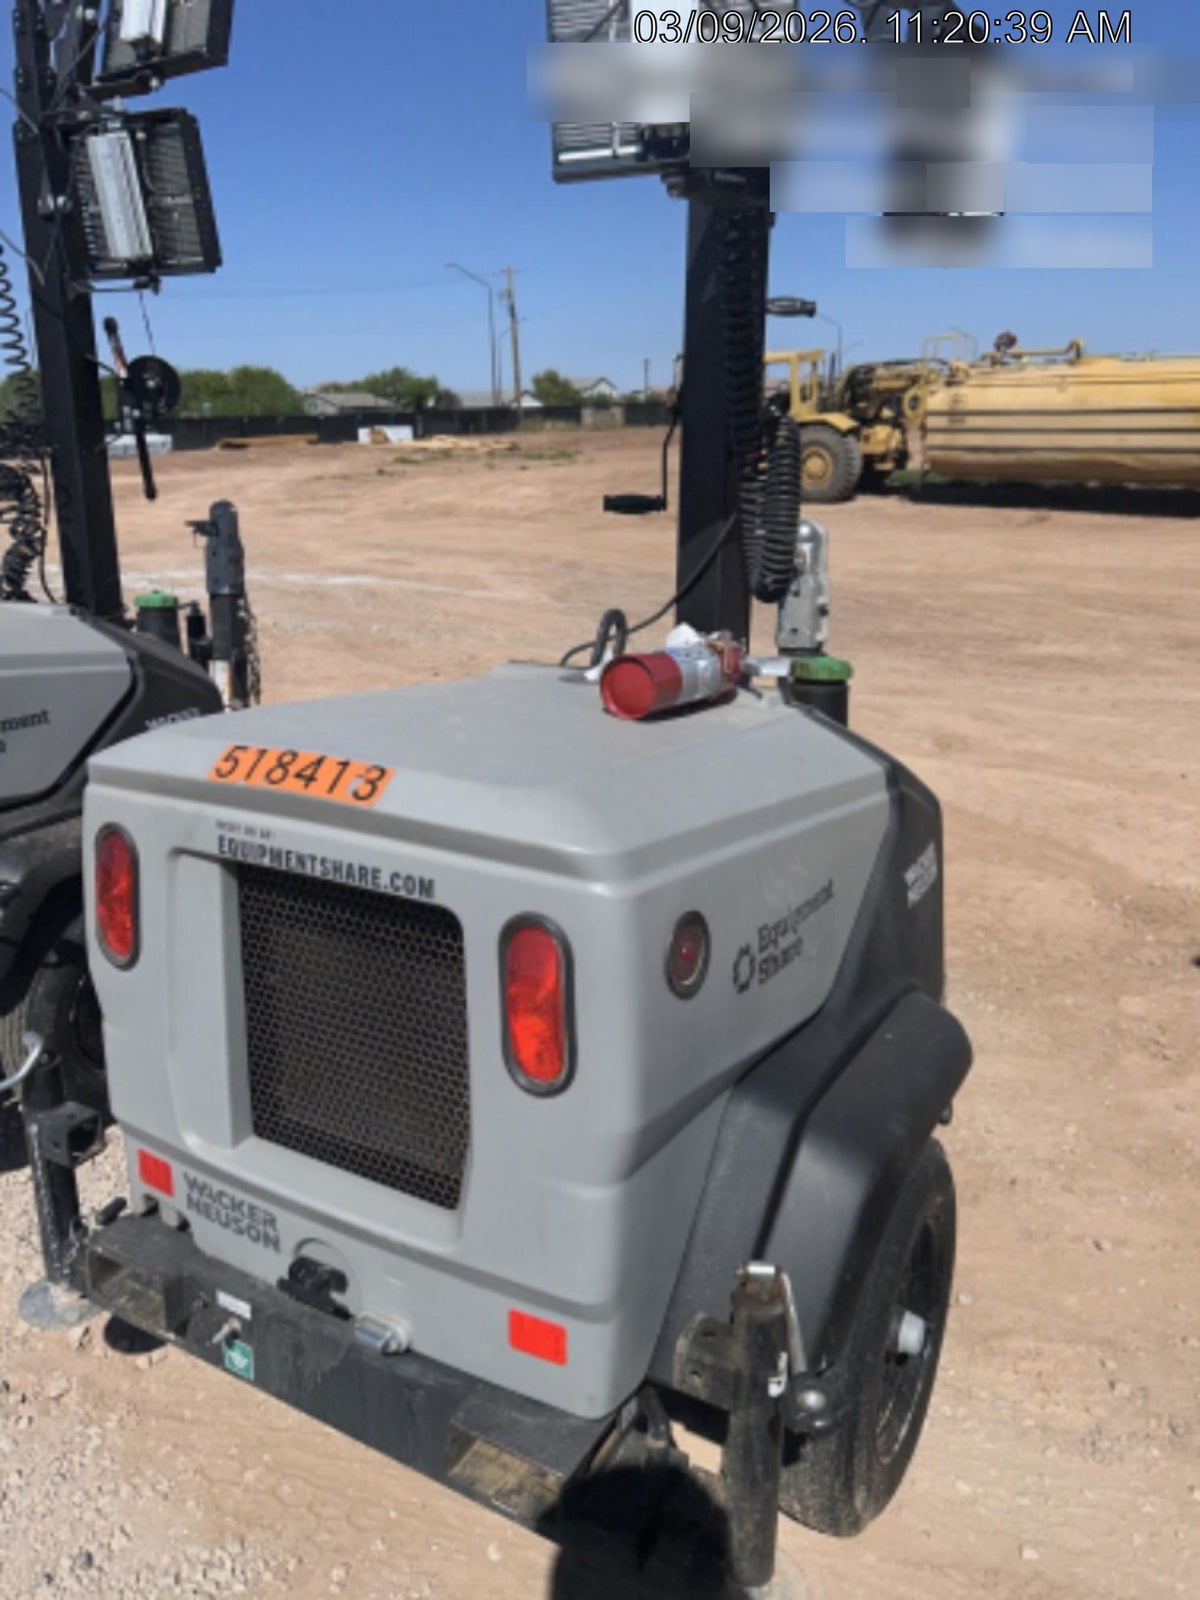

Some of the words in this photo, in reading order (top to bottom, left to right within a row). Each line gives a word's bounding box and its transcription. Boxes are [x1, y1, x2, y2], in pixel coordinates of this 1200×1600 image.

[0, 708, 50, 732] ment
[214, 745, 388, 801] 518413
[217, 834, 436, 899] EQUIPMENTSHARE.COM
[182, 1172, 278, 1228] WACKER
[186, 1193, 281, 1254] NEUSON
